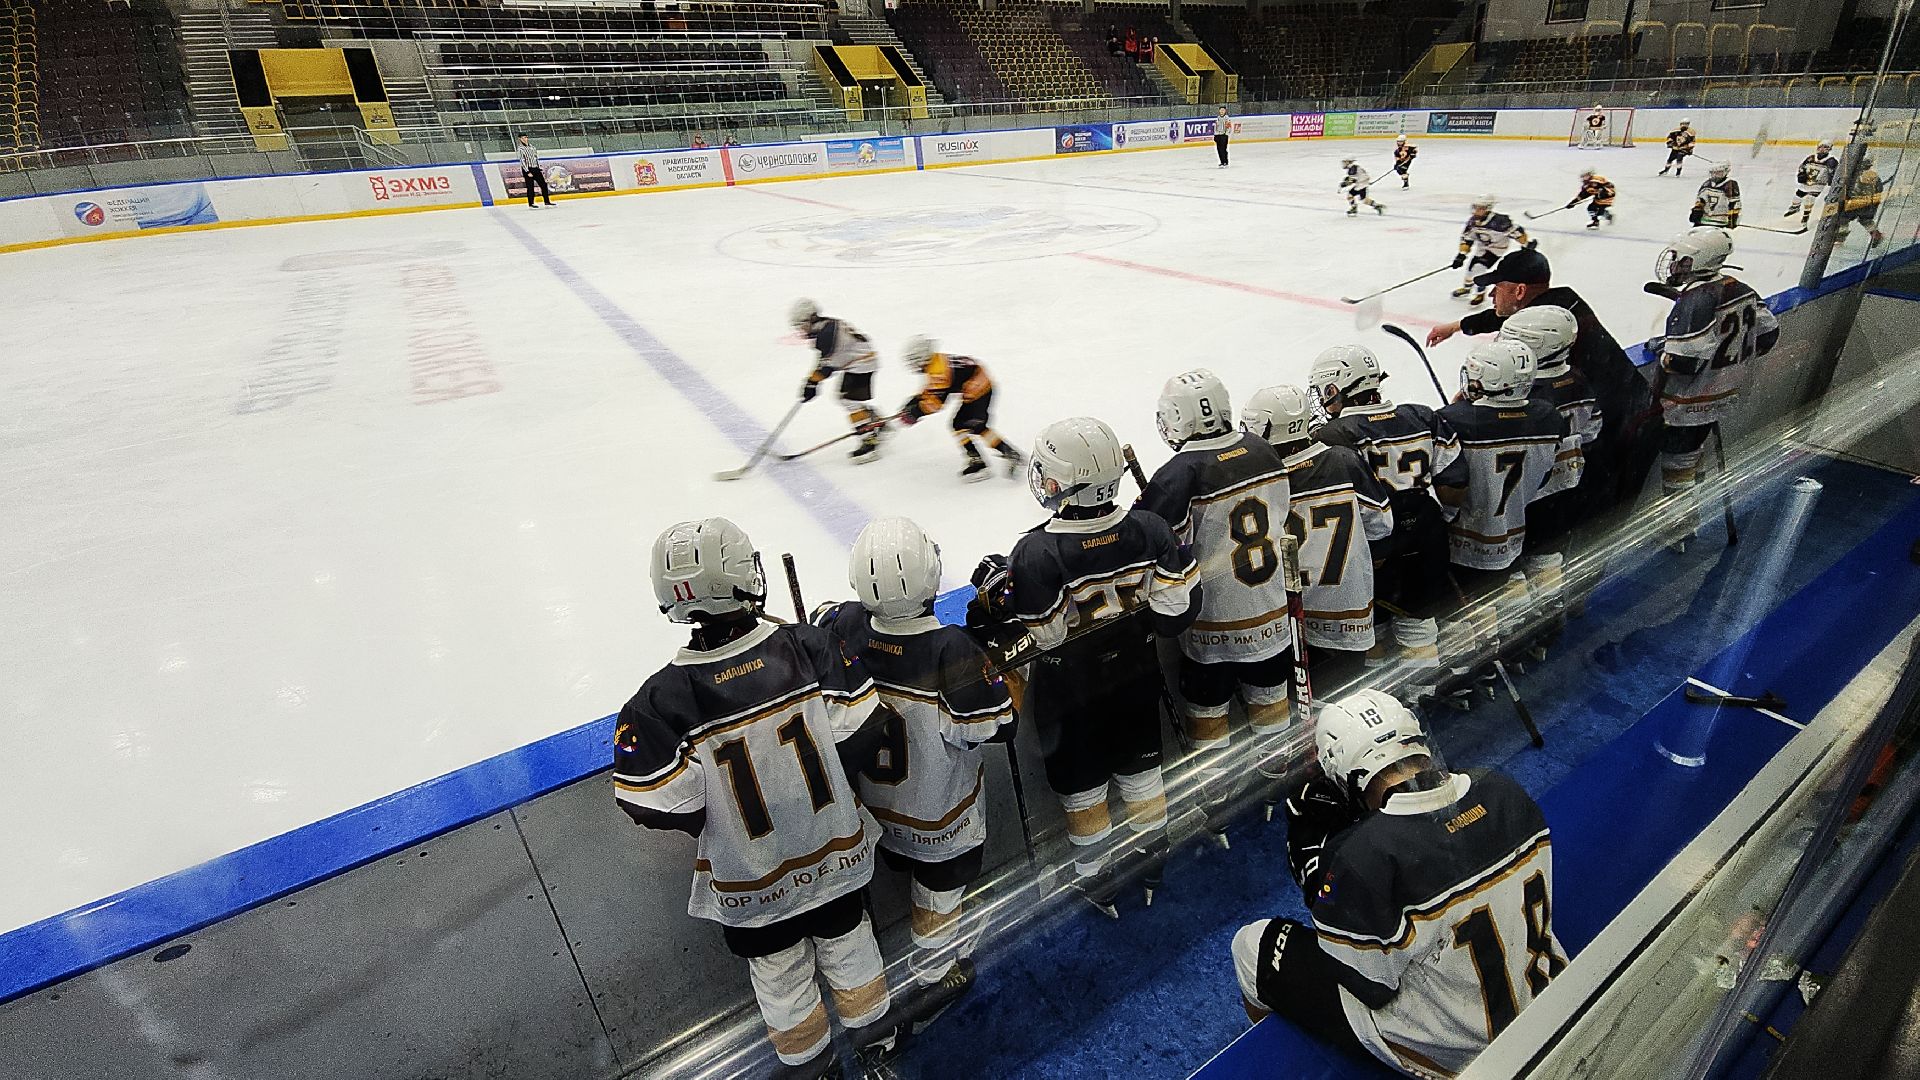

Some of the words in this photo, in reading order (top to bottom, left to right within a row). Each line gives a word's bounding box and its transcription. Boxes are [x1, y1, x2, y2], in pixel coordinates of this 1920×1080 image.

[1292, 115, 1324, 125] КУХНИ
[1292, 124, 1323, 132] ШКАФЫ
[388, 176, 450, 192] ЭХМЗ
[1200, 398, 1213, 417] 8
[1288, 419, 1304, 435] 27
[1096, 482, 1115, 502] 55
[1495, 450, 1528, 517] 7
[1228, 495, 1279, 588] 8
[673, 580, 697, 602] 11
[1190, 633, 1230, 646] СШОР
[1234, 635, 1257, 645] им.
[1261, 622, 1286, 641] Ю.Е.
[1339, 622, 1371, 633] Ляпк
[714, 658, 765, 685] БАЛАШИХА
[1359, 708, 1384, 729] 18
[713, 711, 836, 840] 11
[911, 816, 972, 846] Ляпкина
[759, 887, 790, 905] им.
[793, 862, 834, 888] Ю.Е.
[838, 843, 869, 871] Ляп
[1272, 923, 1293, 972] CCM
[1453, 869, 1568, 1044] 18
